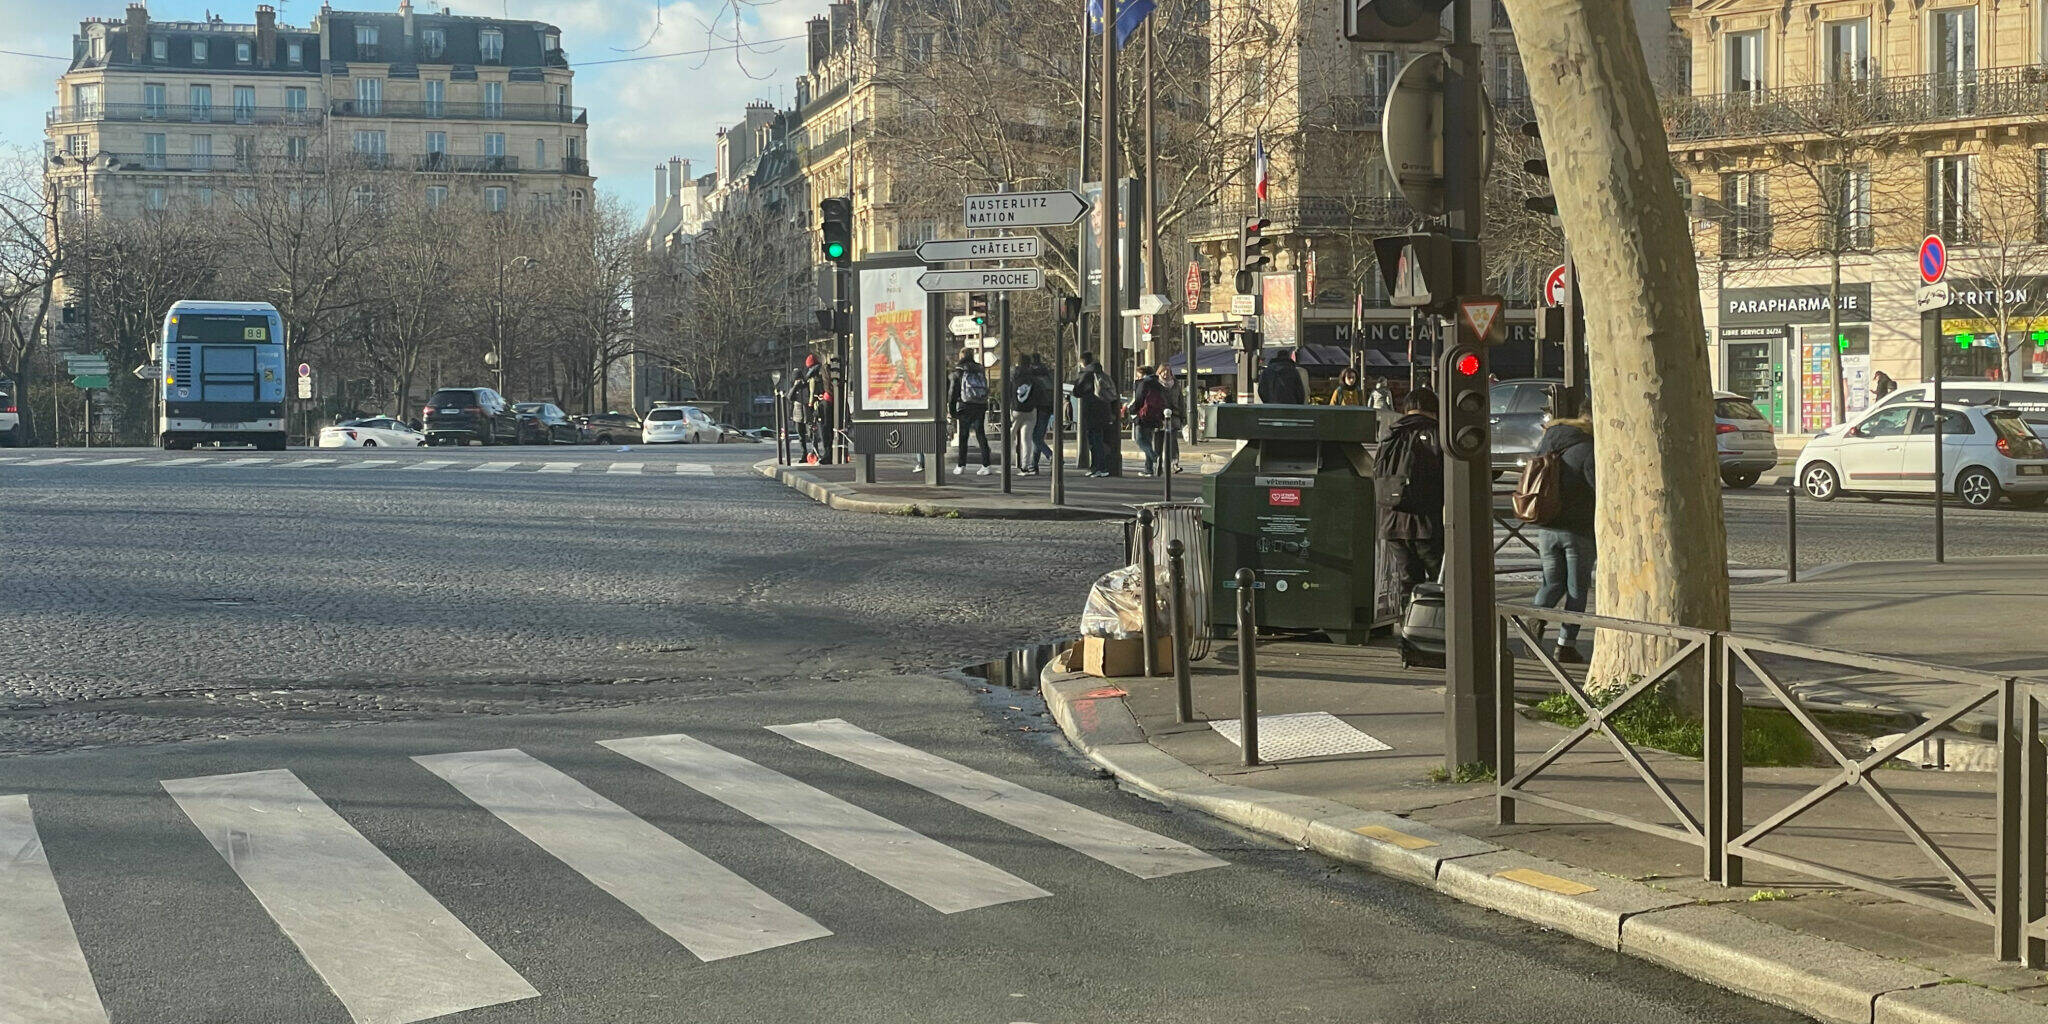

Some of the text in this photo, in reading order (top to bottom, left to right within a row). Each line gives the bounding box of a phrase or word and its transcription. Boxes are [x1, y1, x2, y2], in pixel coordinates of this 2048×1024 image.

[970, 197, 1047, 210] AUSTERLITZ
[970, 212, 1015, 223] NATION
[971, 242, 1033, 255] CHÂTELET
[982, 274, 1029, 285] PROCHE
[1188, 262, 1198, 308] TABAC
[1948, 288, 2028, 306] UTRITION
[247, 328, 262, 339] 88
[1201, 329, 1229, 344] MON
[1740, 328, 1764, 336] SERVICE
[1266, 478, 1306, 486] vêtements
